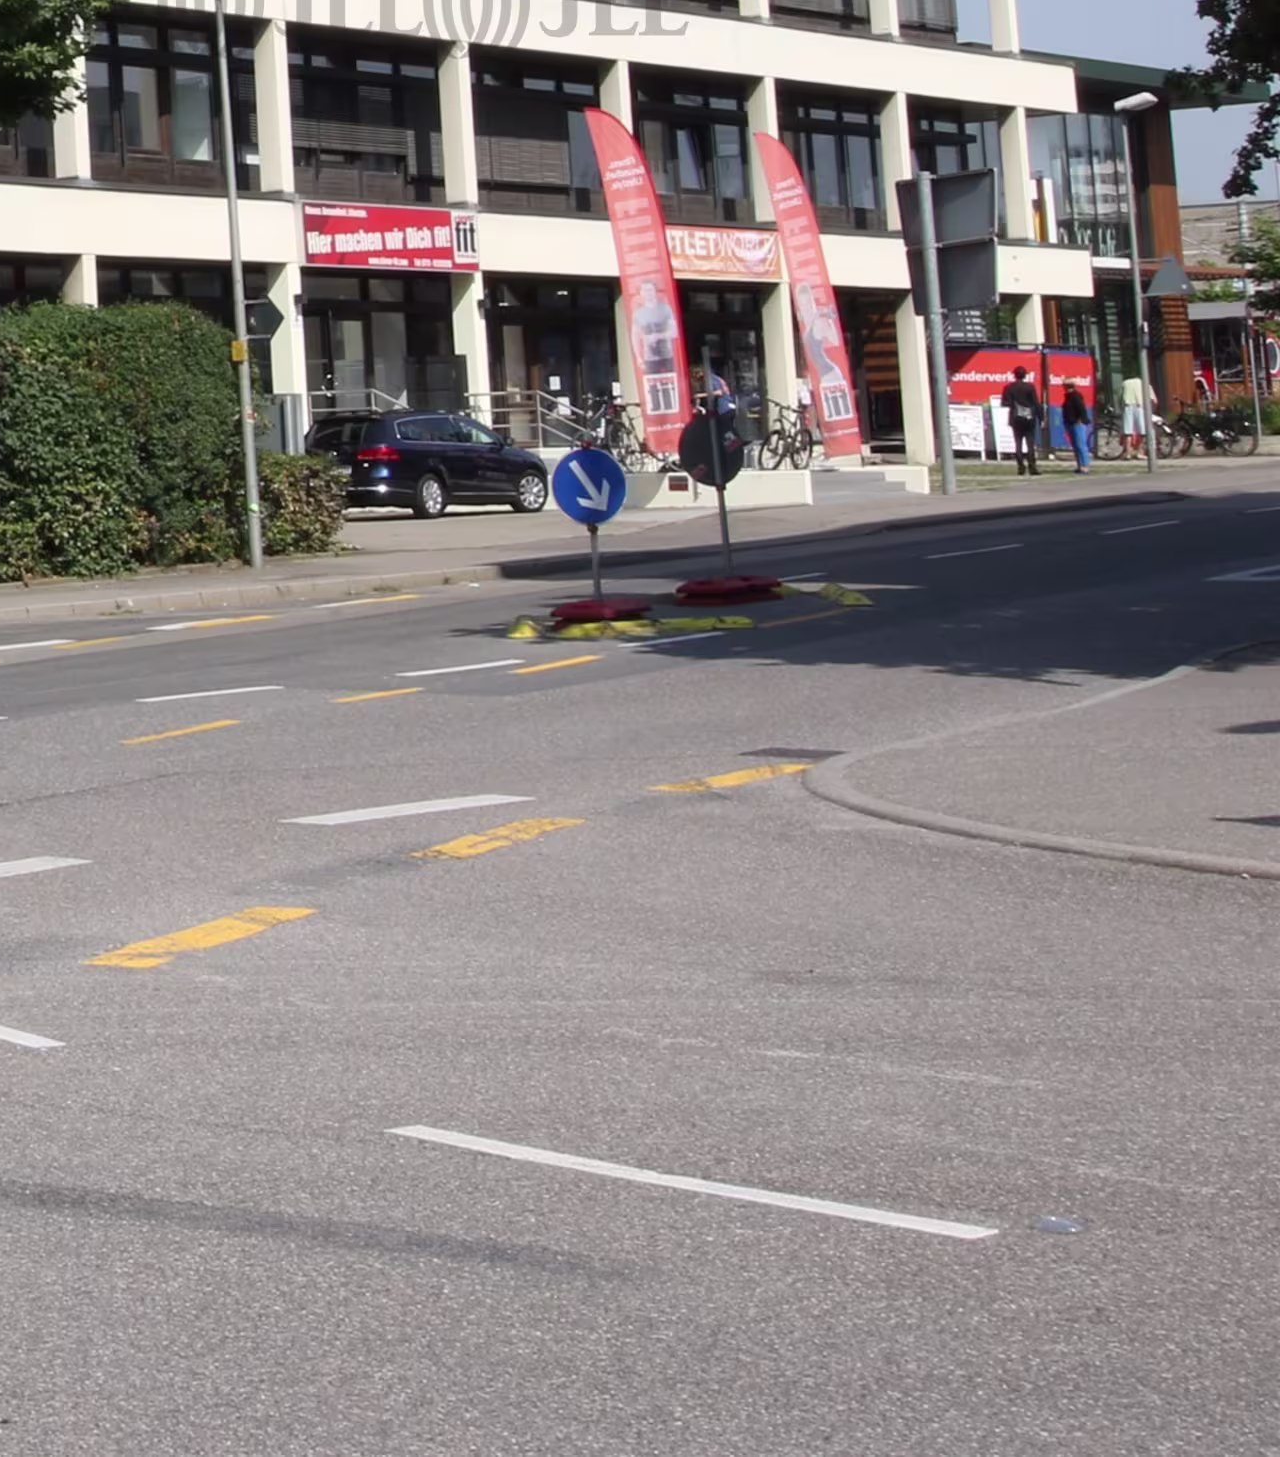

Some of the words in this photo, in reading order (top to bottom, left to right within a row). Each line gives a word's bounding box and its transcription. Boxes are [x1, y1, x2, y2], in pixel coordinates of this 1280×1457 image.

[306, 231, 332, 254] Hier
[334, 229, 383, 252] machen
[384, 227, 403, 250] wir
[405, 225, 432, 249] Dich
[433, 225, 451, 248] fit!
[455, 221, 477, 253] fit
